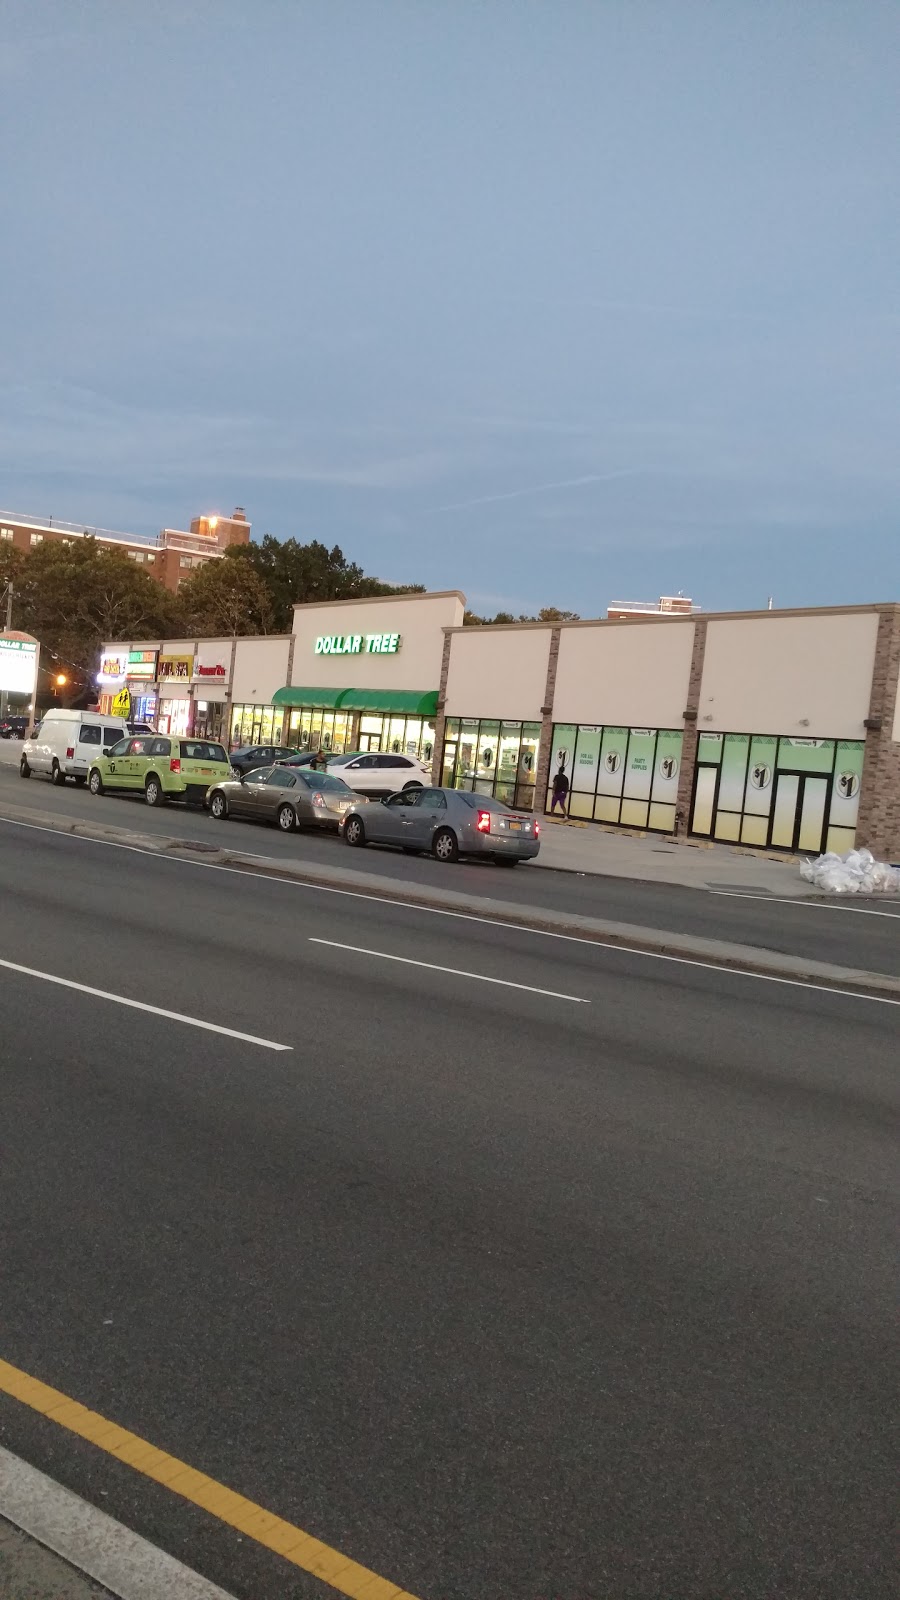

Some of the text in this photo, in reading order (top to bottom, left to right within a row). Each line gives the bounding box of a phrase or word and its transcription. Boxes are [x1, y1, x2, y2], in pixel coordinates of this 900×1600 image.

[314, 633, 401, 655] DOLLAR TREE
[607, 754, 617, 772] $1
[663, 760, 674, 778] $1
[754, 768, 766, 788] $1
[840, 776, 854, 797] $1
